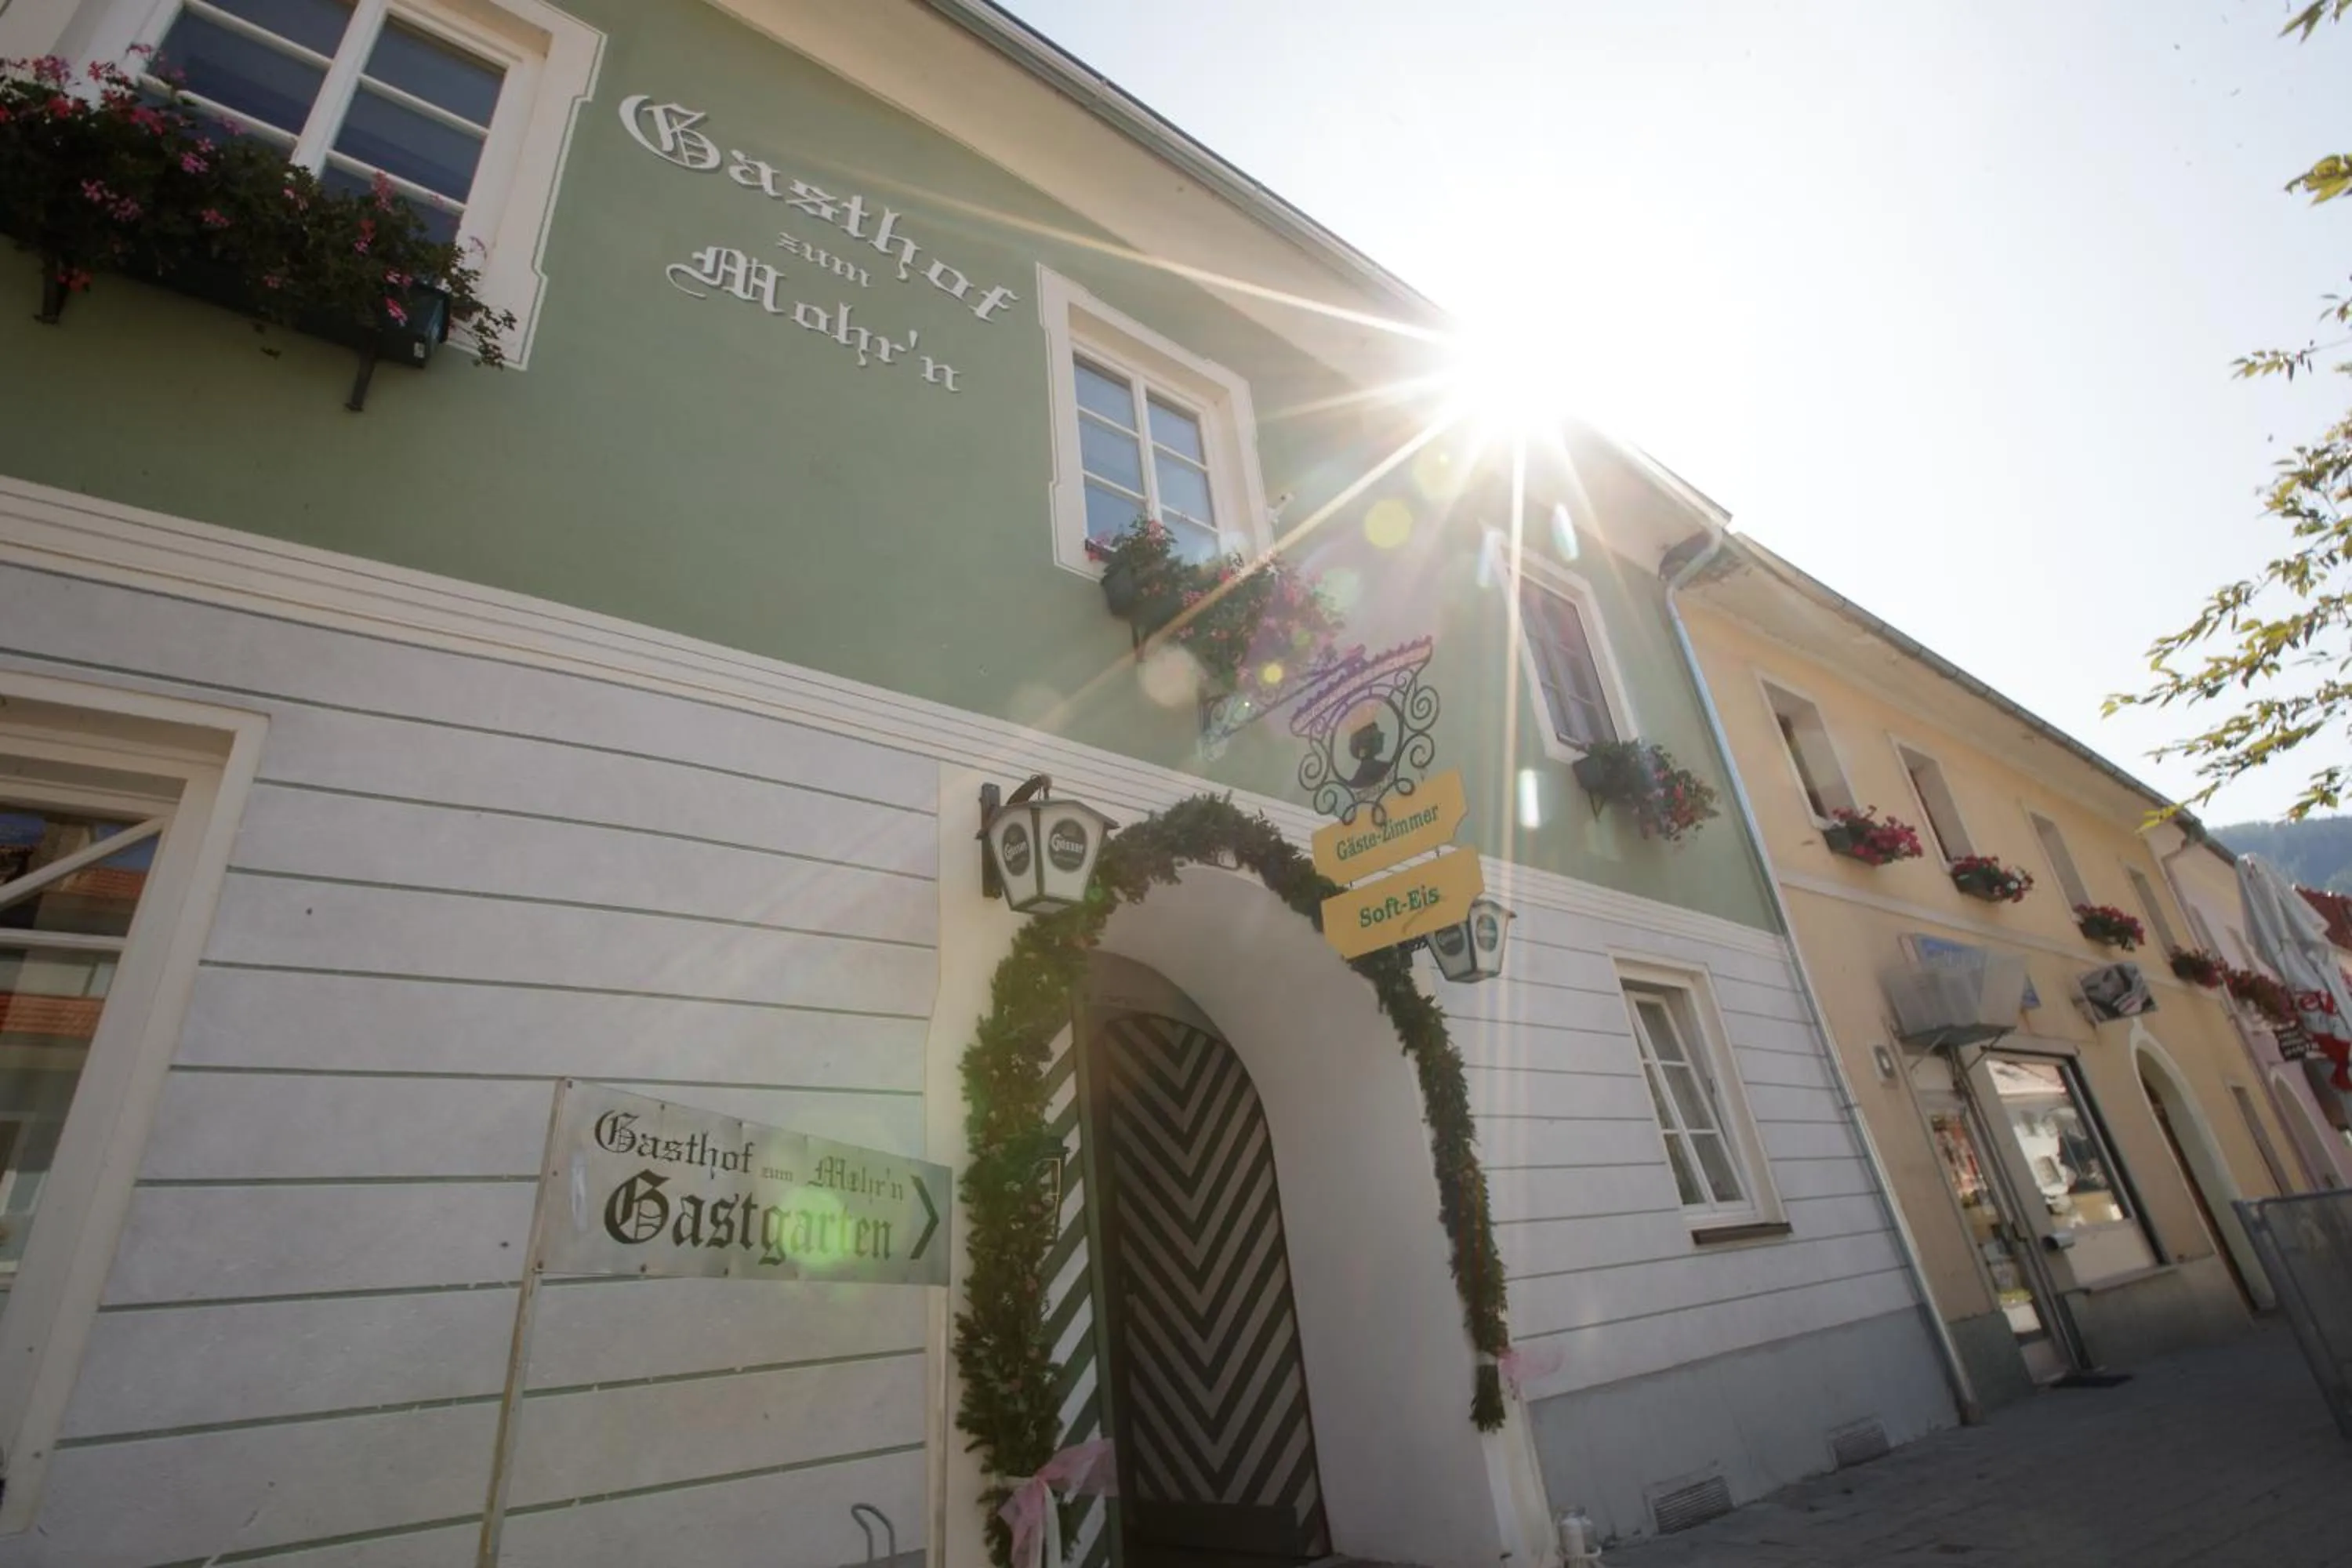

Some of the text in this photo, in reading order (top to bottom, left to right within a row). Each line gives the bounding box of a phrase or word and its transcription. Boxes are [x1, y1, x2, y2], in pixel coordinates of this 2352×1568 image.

[776, 232, 873, 288] zum
[666, 245, 960, 393] Mohr'n
[1336, 804, 1439, 861] Gäste-Zimmer
[1359, 884, 1440, 928] Soft-Eis
[594, 1109, 756, 1179] Gasthof
[761, 1165, 794, 1182] zum
[604, 1168, 892, 1266] Gastgarten
